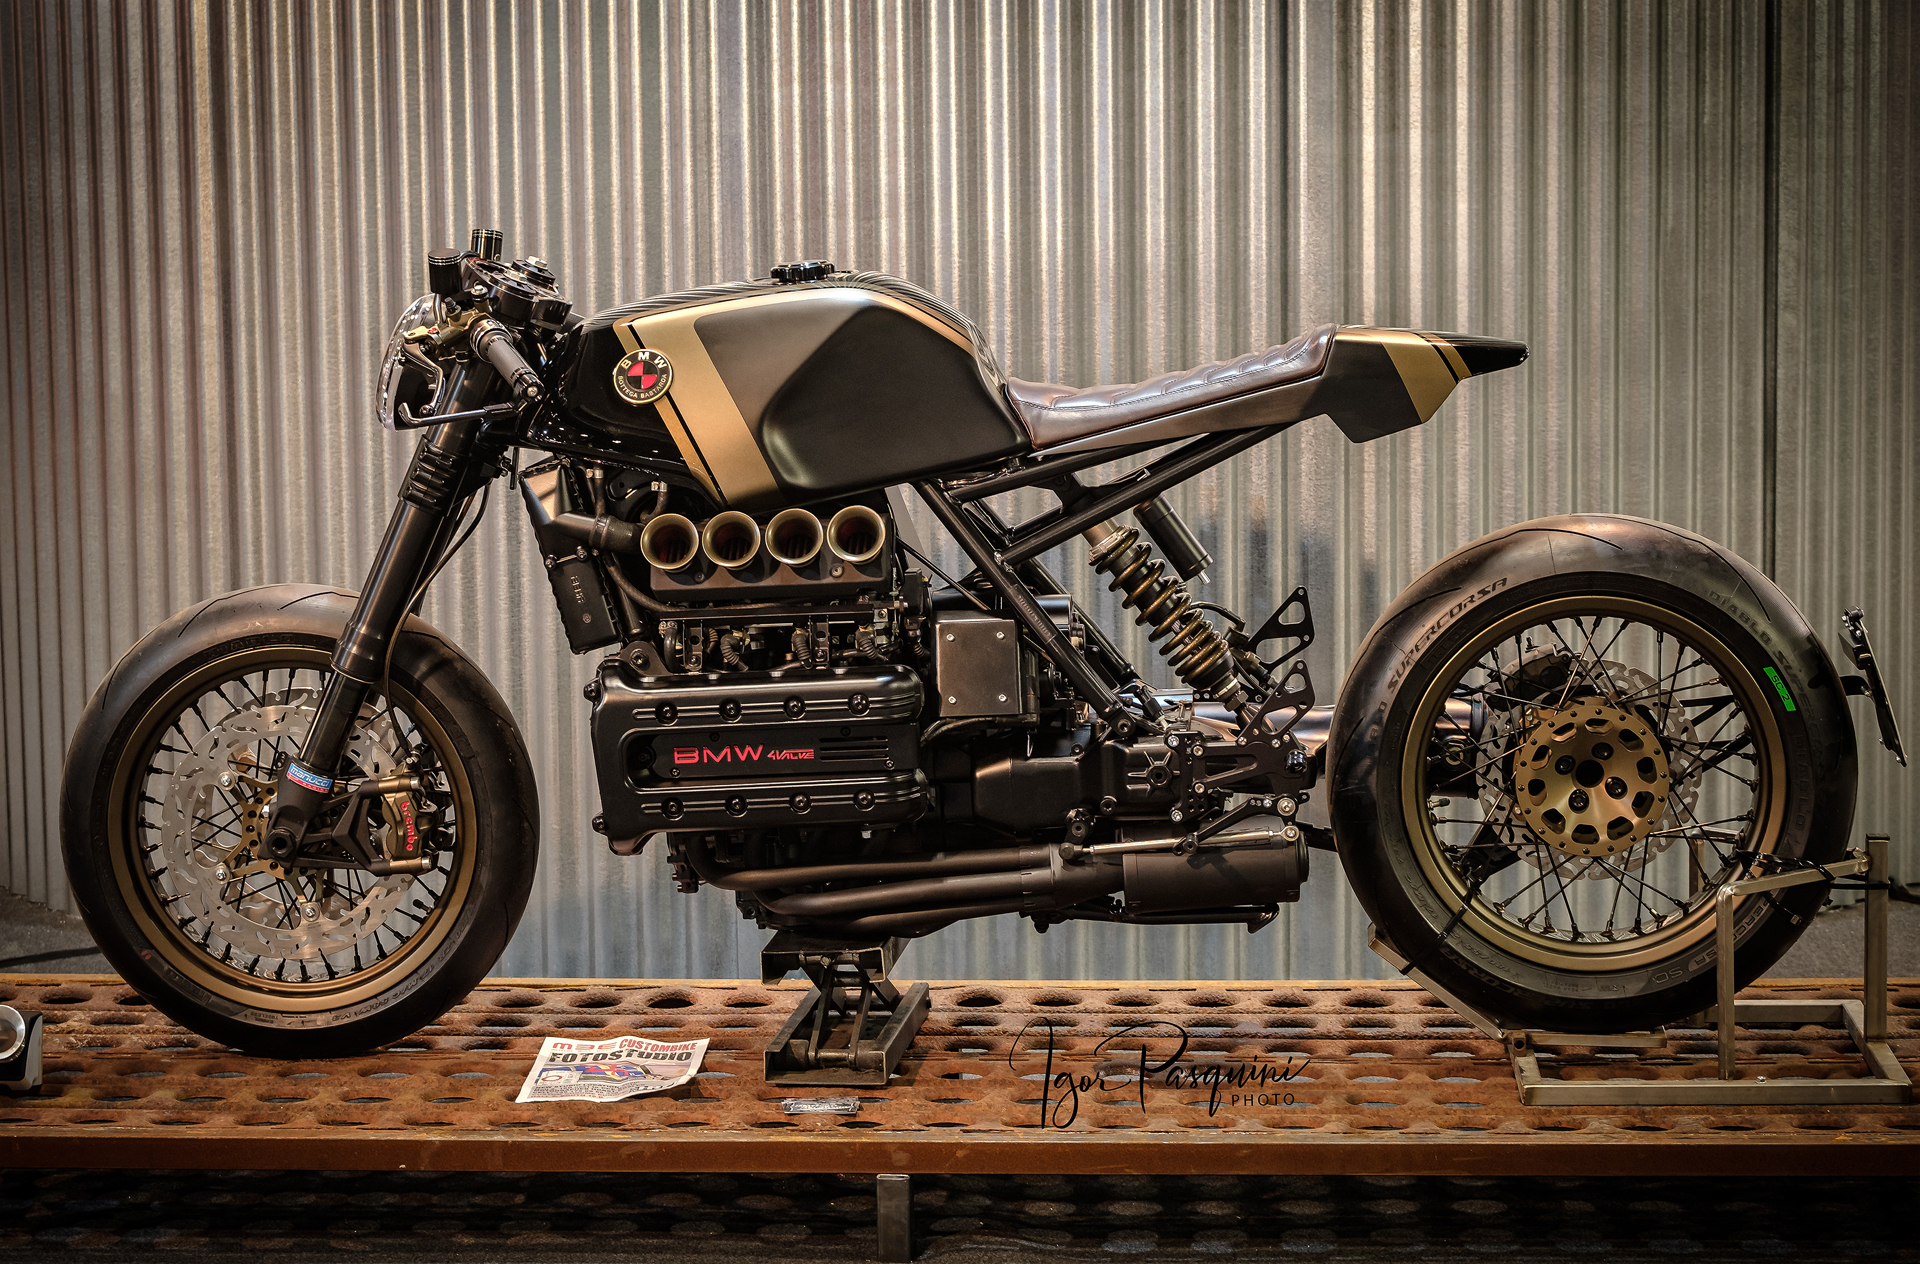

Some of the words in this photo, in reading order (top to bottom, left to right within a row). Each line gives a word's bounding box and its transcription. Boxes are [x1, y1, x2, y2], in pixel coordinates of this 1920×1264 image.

[620, 351, 668, 370] BMW
[617, 375, 638, 398] BOTTEGA
[1708, 590, 1773, 645] DIABLO
[1387, 576, 1508, 693] SUPERCORSA
[1771, 674, 1784, 691] SC
[1781, 694, 1790, 702] 2
[673, 744, 765, 765] BMW
[767, 748, 815, 761] 4VALVE
[400, 801, 417, 851] brembo
[549, 1048, 694, 1063] FOTOSTUDIO
[618, 1038, 698, 1053] CUSTOMBIKE
